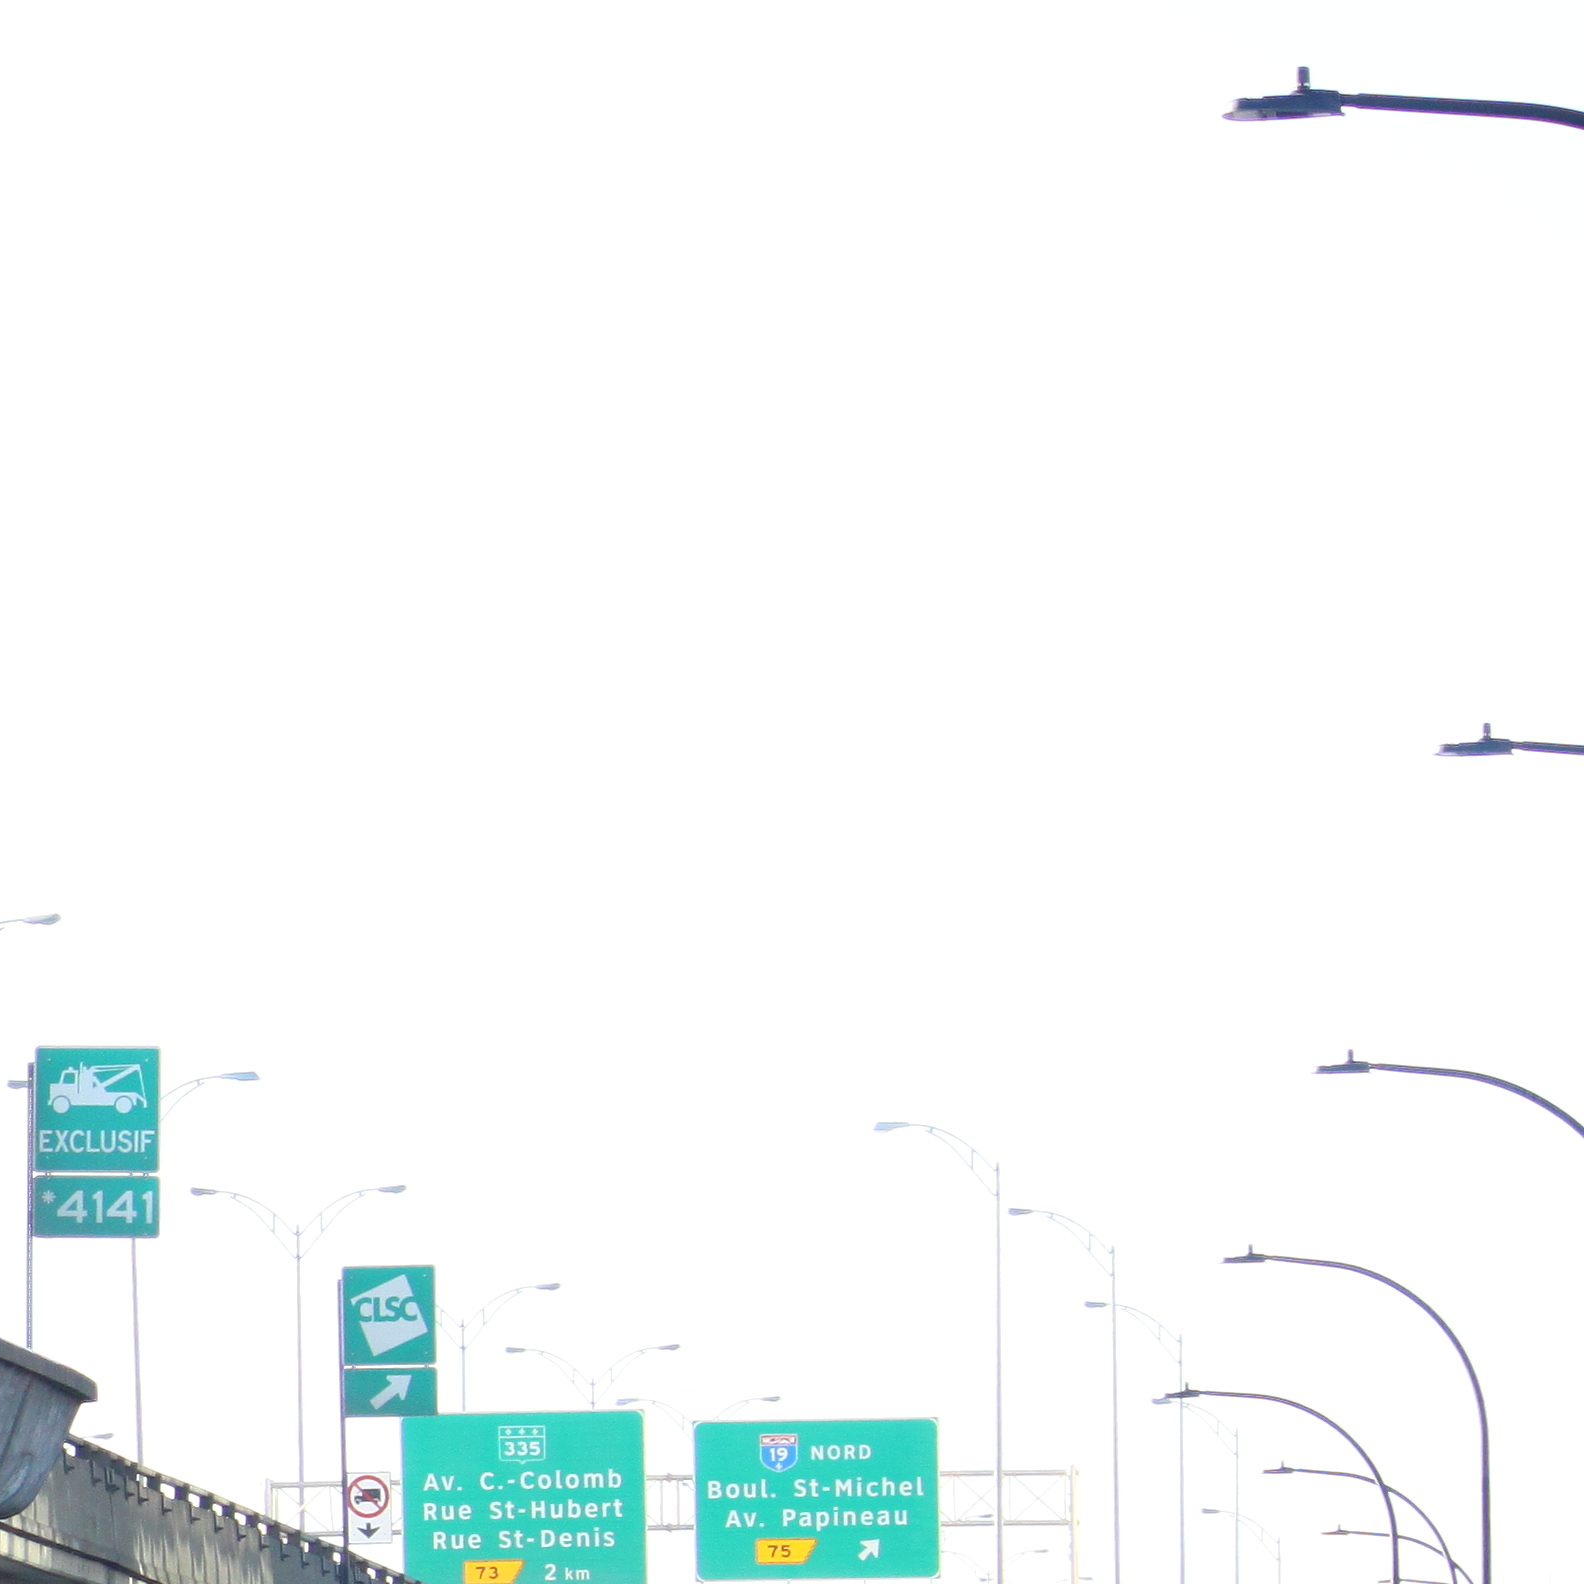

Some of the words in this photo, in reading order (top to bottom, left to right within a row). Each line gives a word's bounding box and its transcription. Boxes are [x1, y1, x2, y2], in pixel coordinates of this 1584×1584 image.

[38, 1129, 155, 1153] EXCLUSIF
[355, 1295, 420, 1323] CLSC
[504, 1441, 541, 1456] 335
[769, 1448, 789, 1462] 19
[810, 1444, 872, 1461] NORD
[422, 1473, 464, 1492] Av.
[479, 1468, 623, 1491] C.-Colomb
[707, 1478, 777, 1499] Boul.
[793, 1476, 925, 1498] St-Michel
[423, 1503, 473, 1521] Rue
[489, 1498, 624, 1520] St-Hubert
[725, 1509, 765, 1528] Av.
[782, 1506, 909, 1532] Papineau
[432, 1531, 482, 1550] Rue
[498, 1527, 616, 1549] St-Denis
[767, 1544, 791, 1558] 75
[475, 1566, 500, 1580] 73
[544, 1563, 557, 1581] 2
[564, 1567, 590, 1581] km
